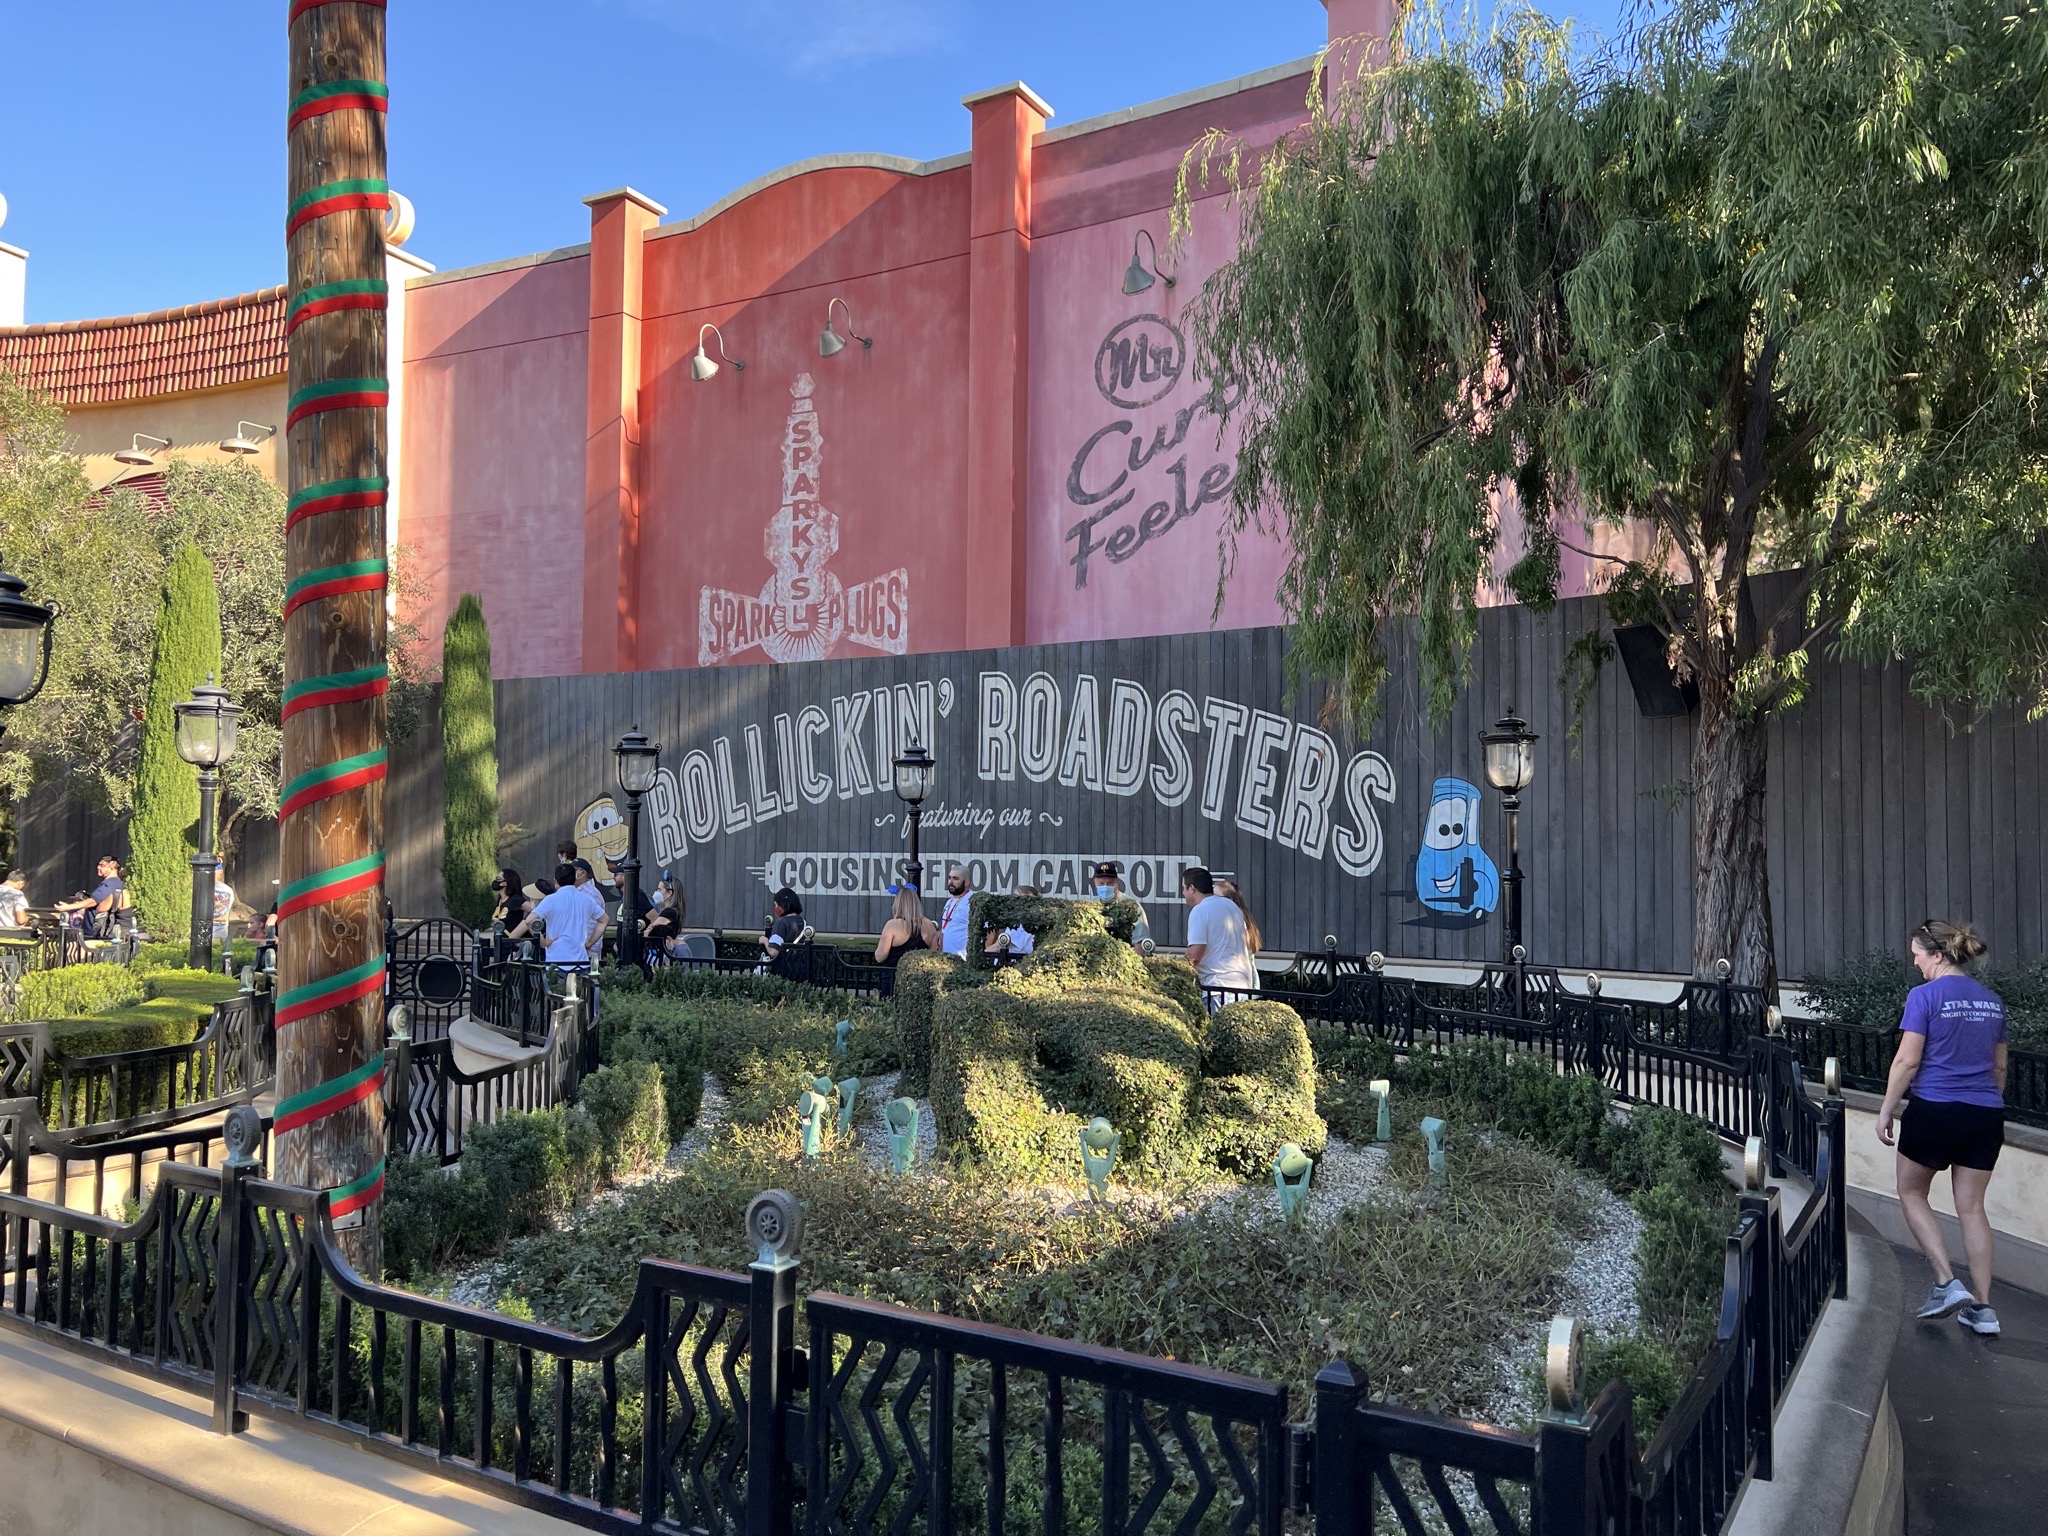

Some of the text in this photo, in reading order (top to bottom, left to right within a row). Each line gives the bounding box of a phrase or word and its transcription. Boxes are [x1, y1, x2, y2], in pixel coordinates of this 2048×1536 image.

[789, 419, 816, 601] SPARKYS
[1065, 453, 1252, 591] Feele
[708, 576, 902, 655] SPARK PLUGS
[900, 801, 1033, 840] faturing our
[977, 670, 1397, 878] ROADSTERS
[1941, 1000, 2001, 1011] STAR WARS
